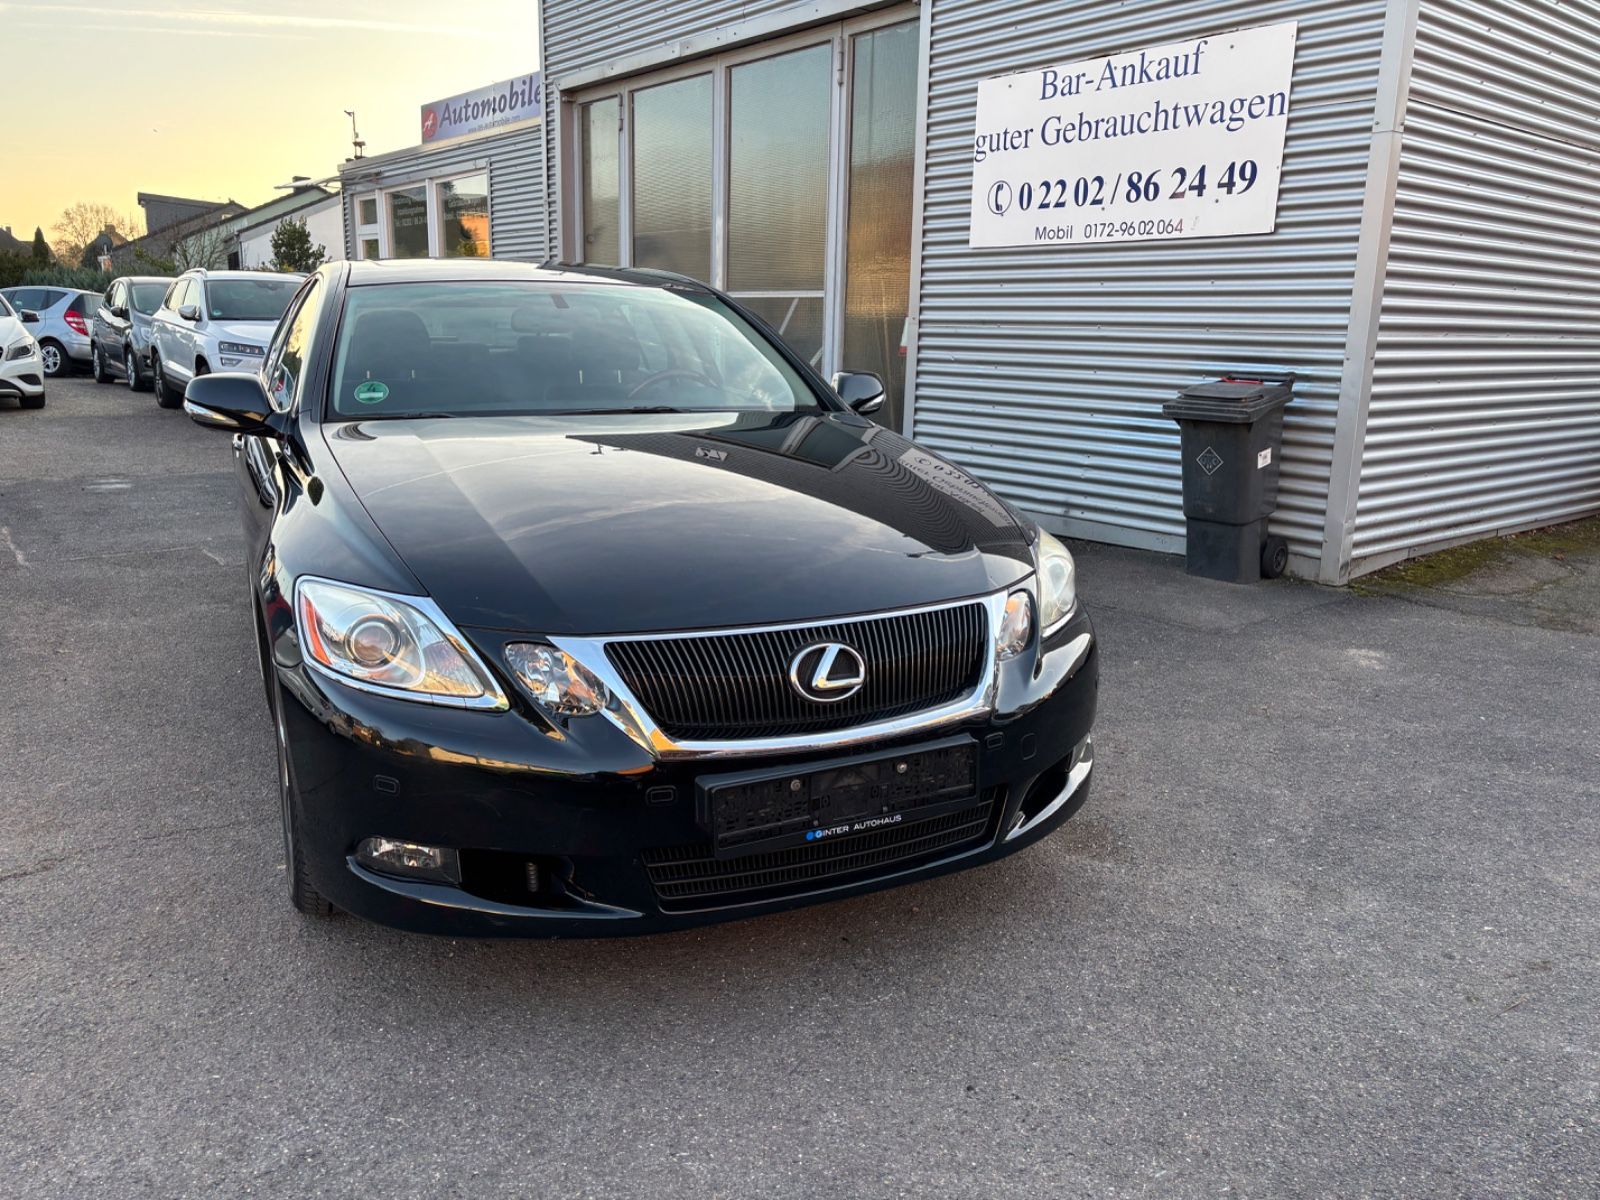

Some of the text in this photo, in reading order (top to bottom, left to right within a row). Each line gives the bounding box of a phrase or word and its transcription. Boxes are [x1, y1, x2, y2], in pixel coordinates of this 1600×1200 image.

[1040, 40, 1209, 101] Bar-Ankauf
[974, 90, 1287, 163] guter Gebrauchtwagen
[1034, 225, 1074, 241] Mobil
[814, 814, 902, 839] GINTER AUTOHAUS
